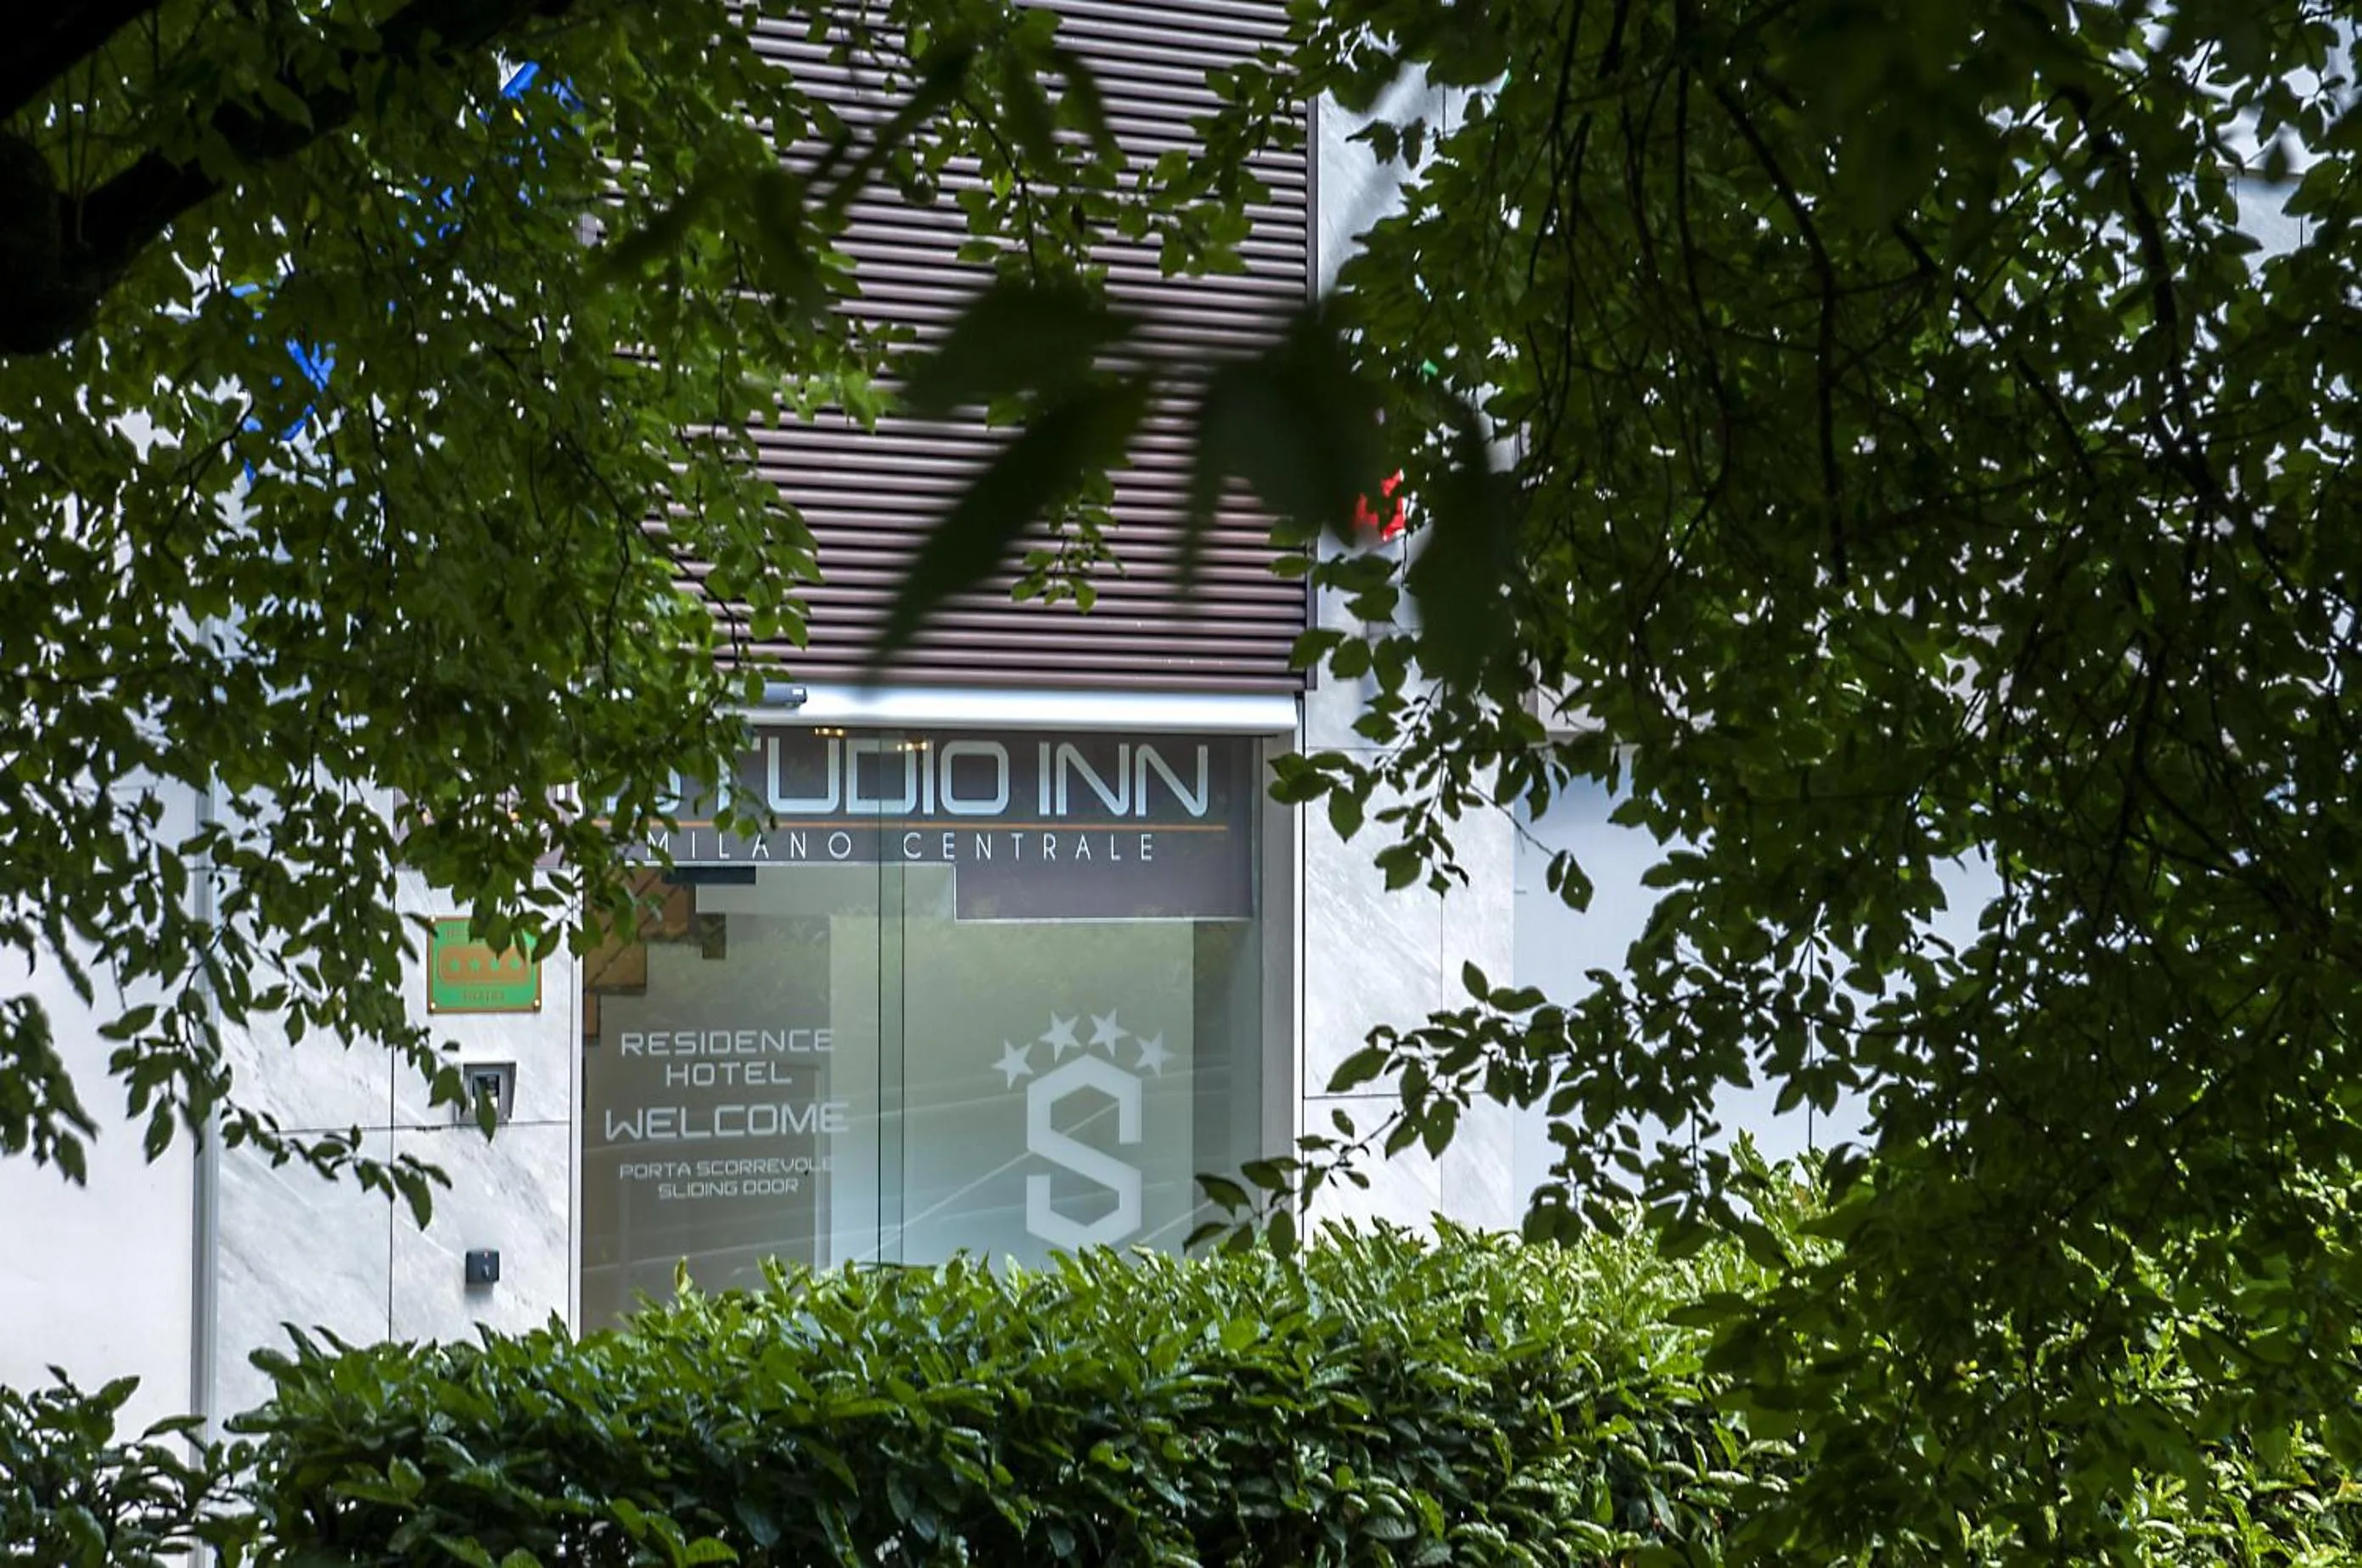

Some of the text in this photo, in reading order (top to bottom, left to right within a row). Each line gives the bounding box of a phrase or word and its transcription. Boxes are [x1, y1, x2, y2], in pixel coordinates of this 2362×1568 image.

[1038, 741, 1209, 817] INN
[647, 831, 1153, 861] MILANO CENTRALE
[621, 1029, 834, 1056] RESIDENCE
[665, 1061, 792, 1087] HOTEL
[605, 1103, 850, 1141] WELCOME
[620, 1162, 691, 1179] PORTA
[659, 1178, 799, 1200] SLIDING DOOR
